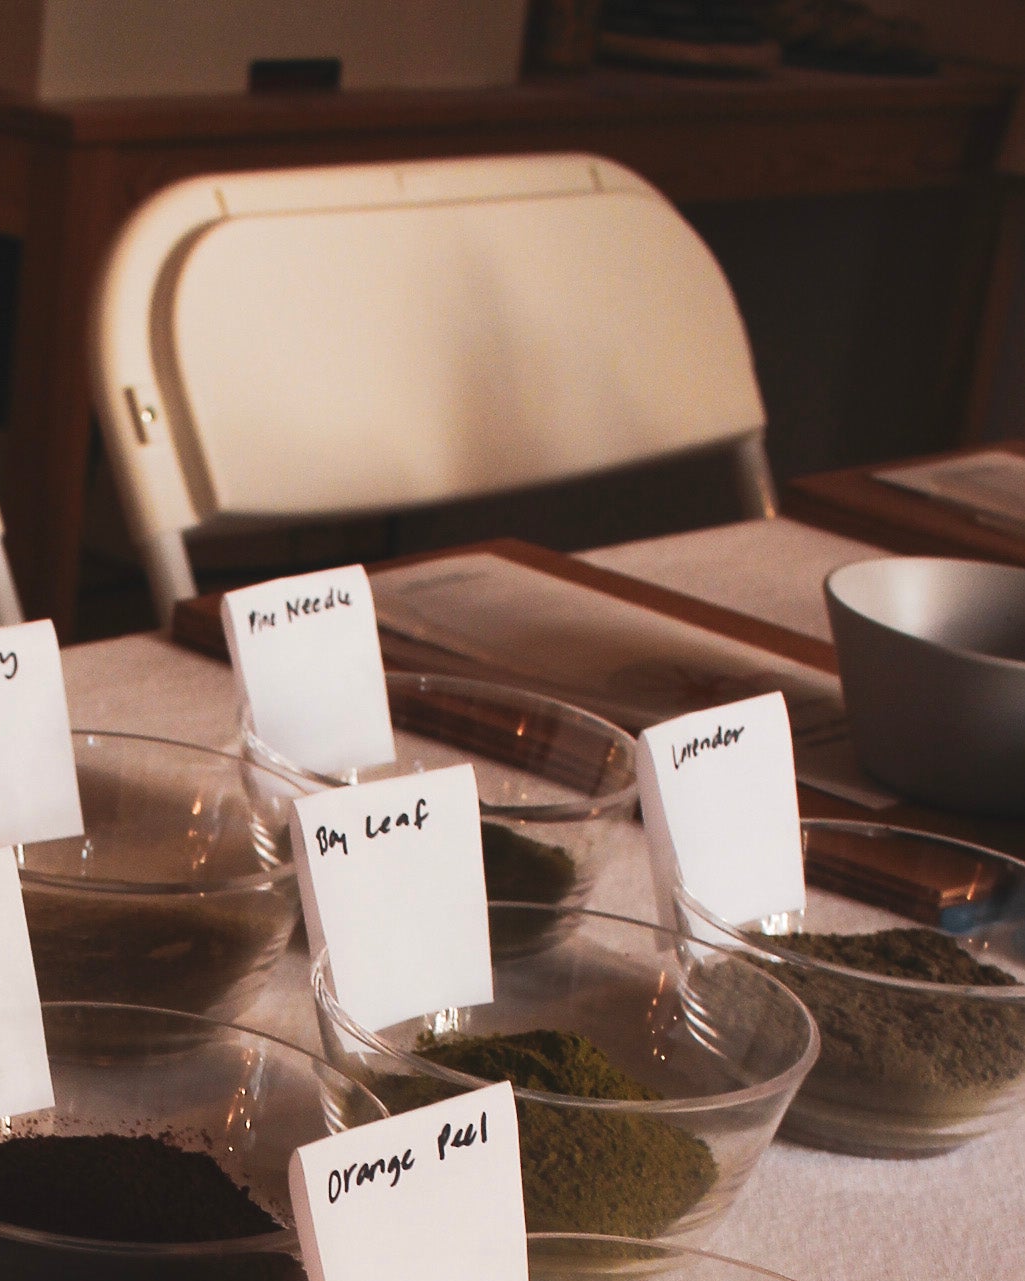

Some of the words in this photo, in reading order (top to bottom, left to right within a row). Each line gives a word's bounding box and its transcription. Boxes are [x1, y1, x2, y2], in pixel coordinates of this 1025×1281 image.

[314, 825, 350, 857] Bay
[364, 797, 431, 840] Leaf
[327, 1147, 417, 1205] Orange
[436, 1110, 490, 1161] Peel
